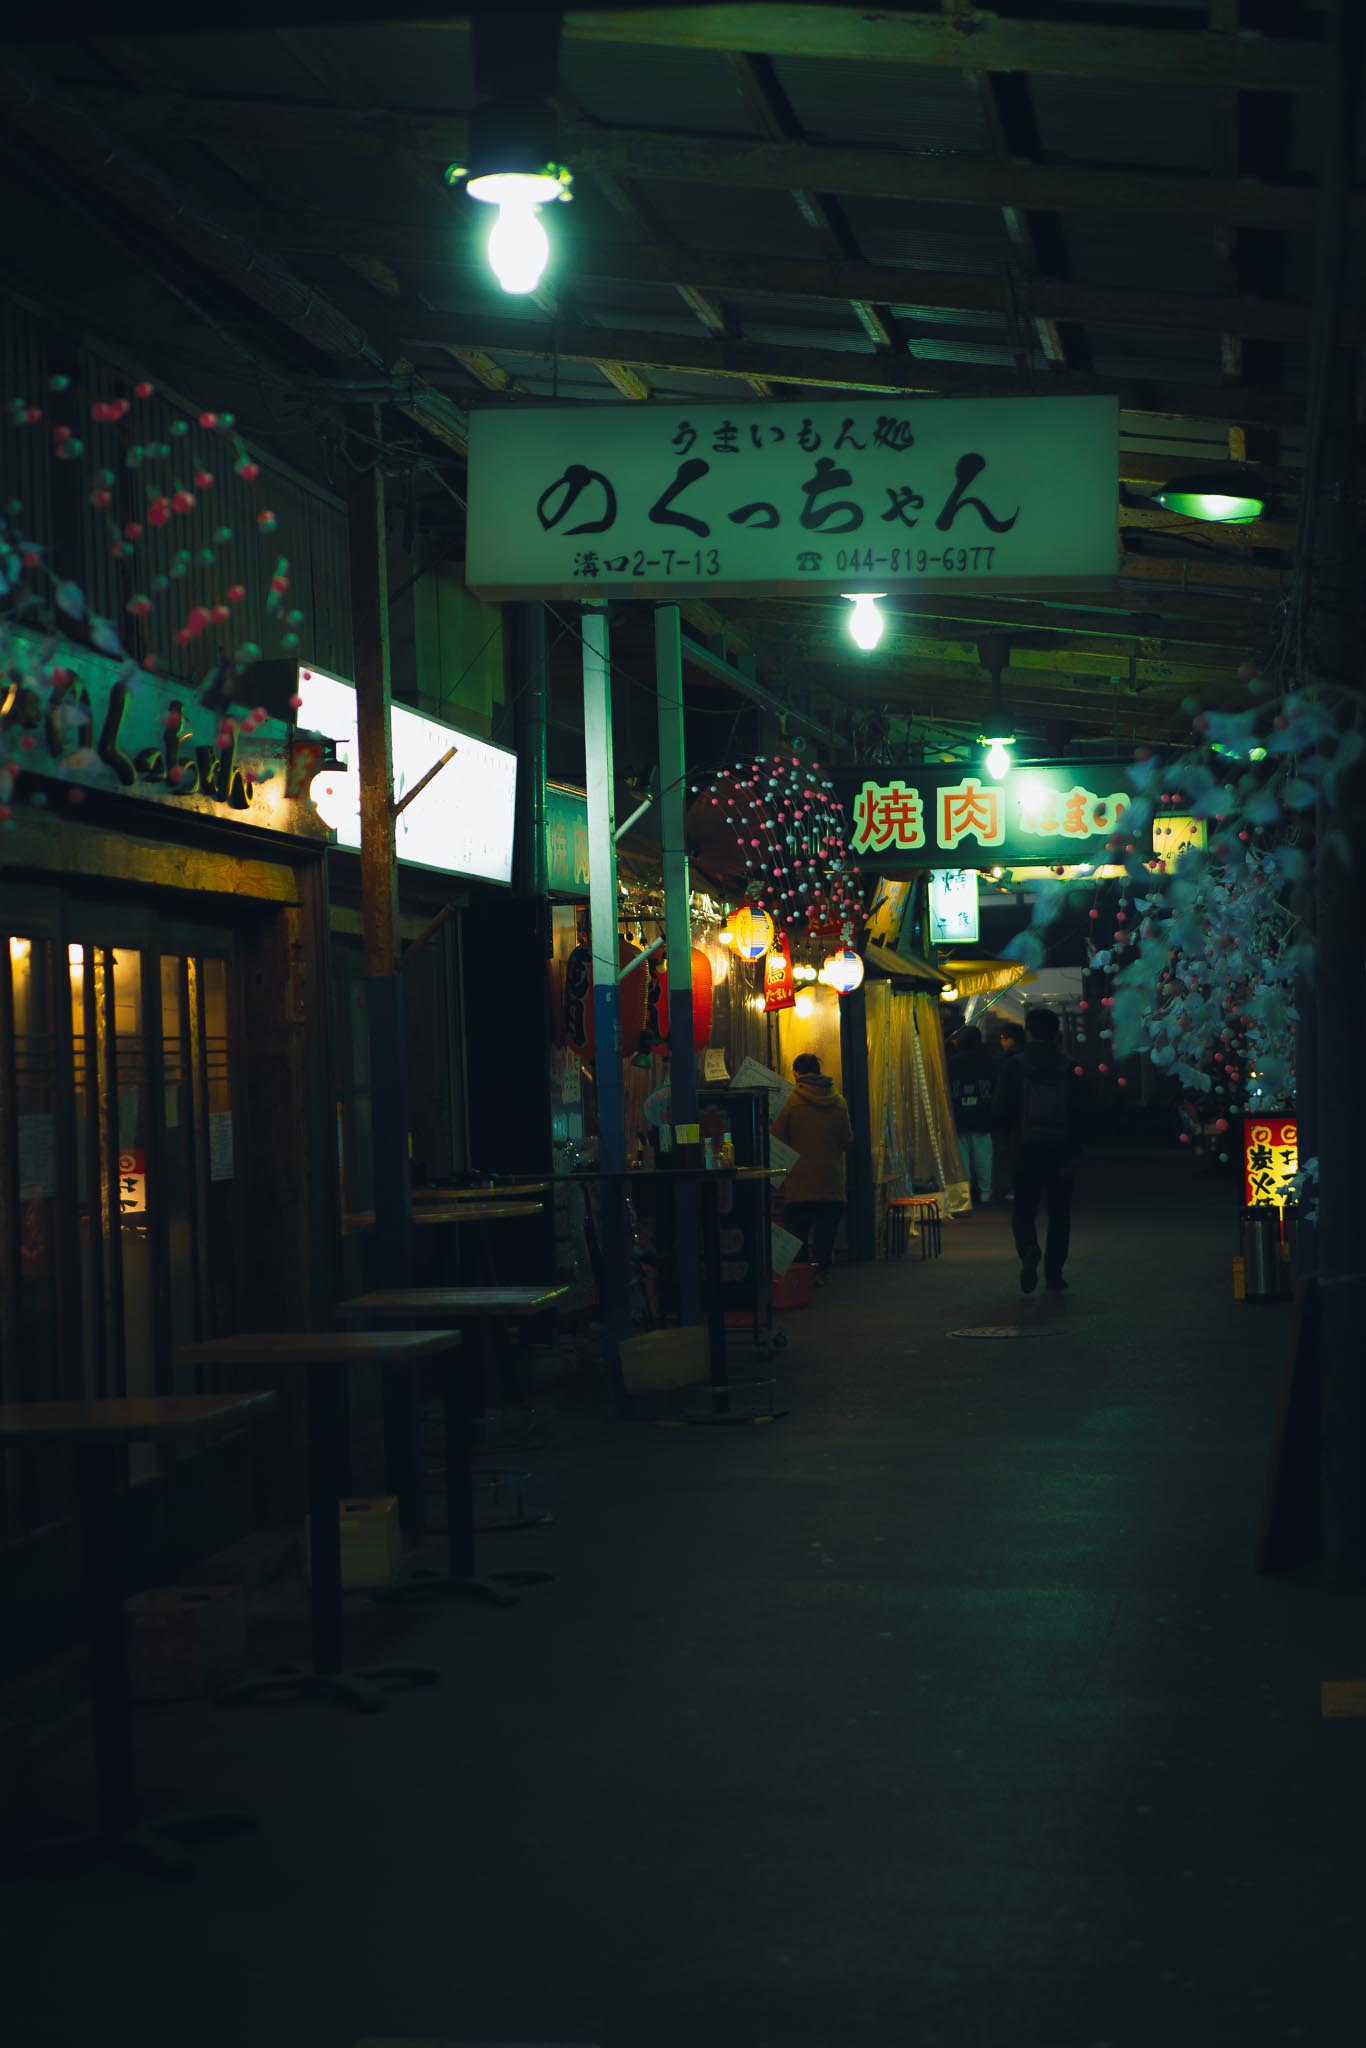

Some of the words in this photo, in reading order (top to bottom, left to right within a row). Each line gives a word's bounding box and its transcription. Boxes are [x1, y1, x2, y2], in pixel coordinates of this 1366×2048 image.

[672, 416, 914, 455] うまいもん処
[537, 452, 1019, 537] のくっちゃん
[574, 549, 721, 578] 溝口2-7-13
[836, 546, 996, 573] 044-819-6977
